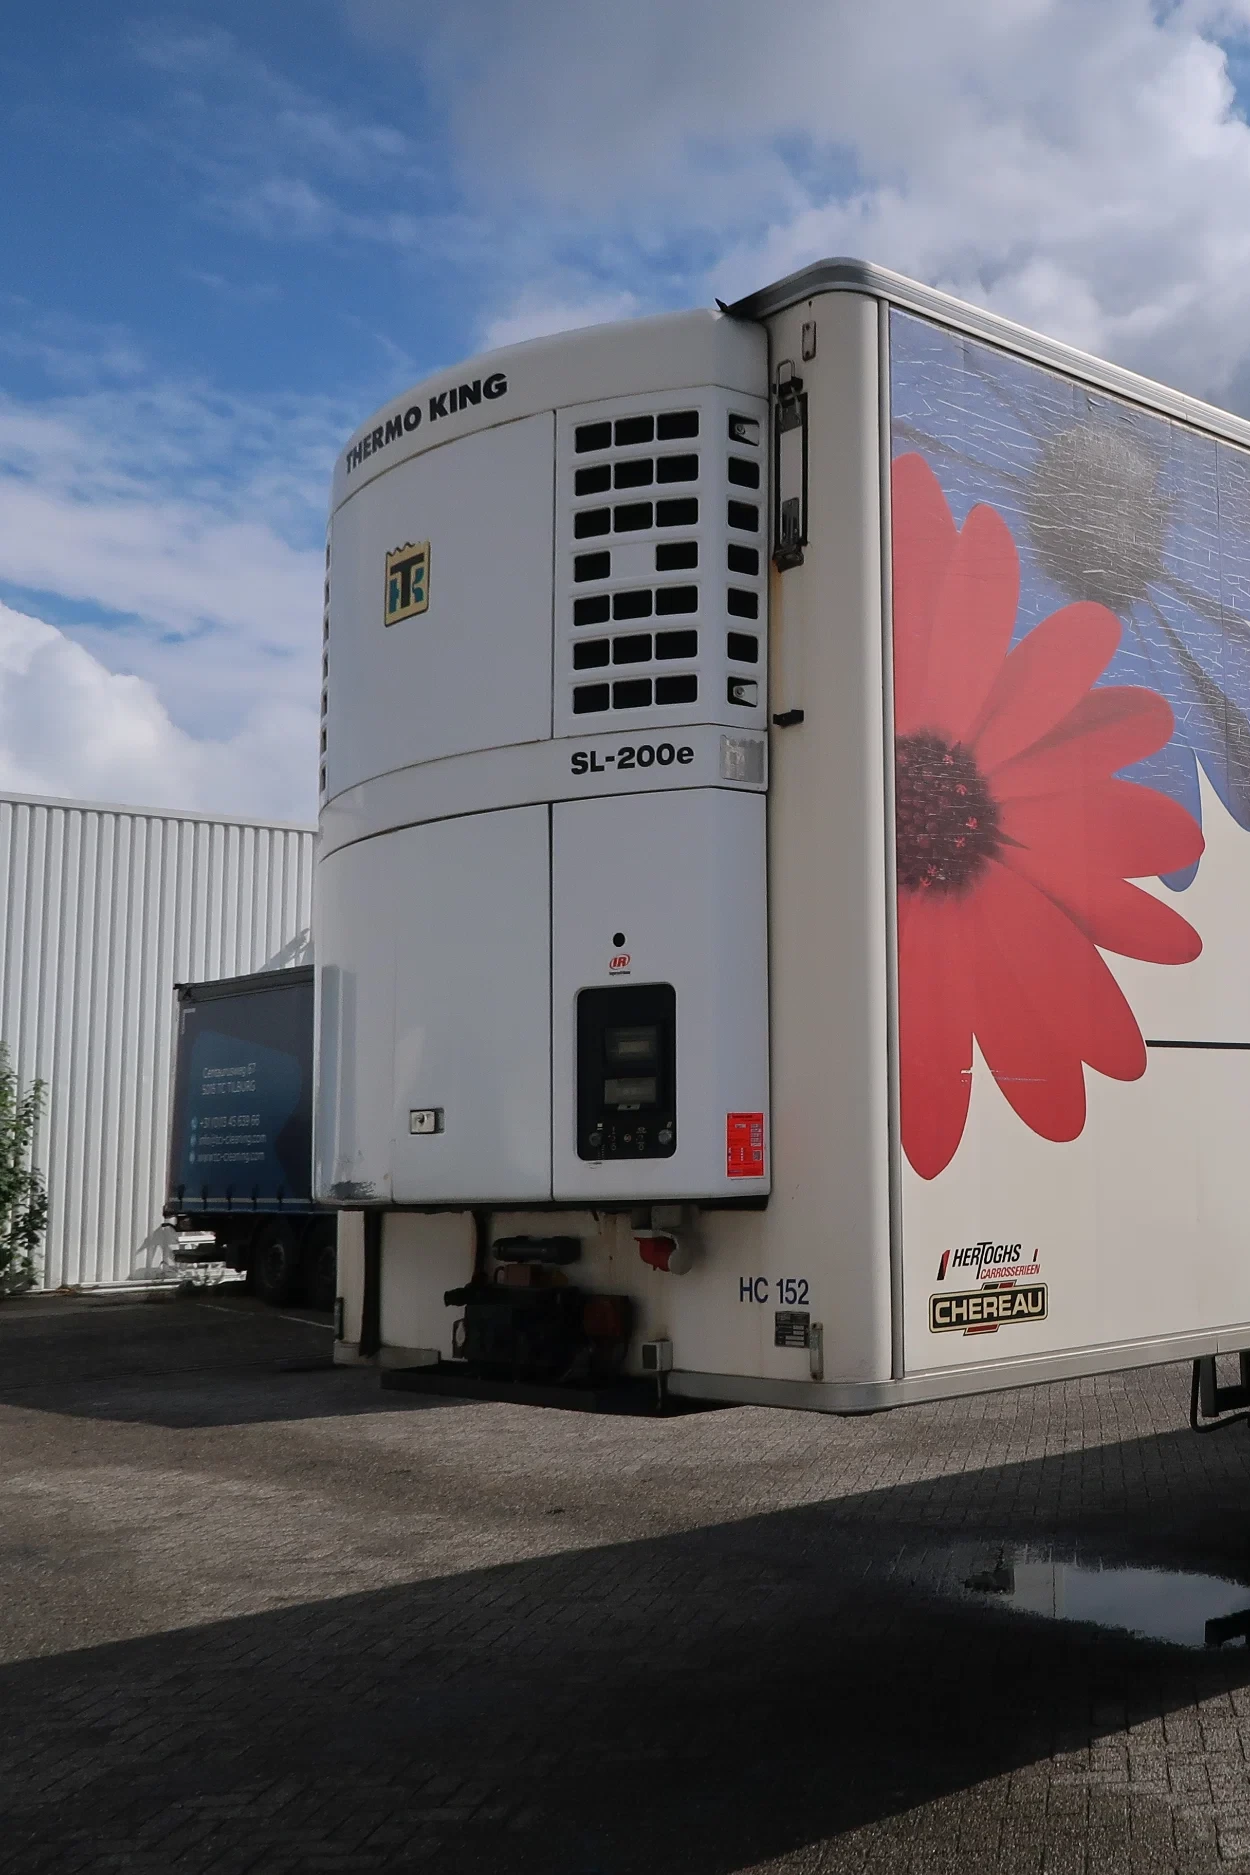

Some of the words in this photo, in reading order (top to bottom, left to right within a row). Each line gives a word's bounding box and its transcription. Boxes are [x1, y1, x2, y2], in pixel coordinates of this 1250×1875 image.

[346, 406, 422, 475] THERMO
[429, 373, 508, 422] KING
[570, 743, 695, 775] SL-200e
[952, 1241, 1021, 1280] HERTOGHS
[980, 1264, 1041, 1280] CARROSSERIEEN
[739, 1276, 768, 1304] HC
[776, 1278, 810, 1305] 152
[935, 1291, 1043, 1324] CHEREAU
